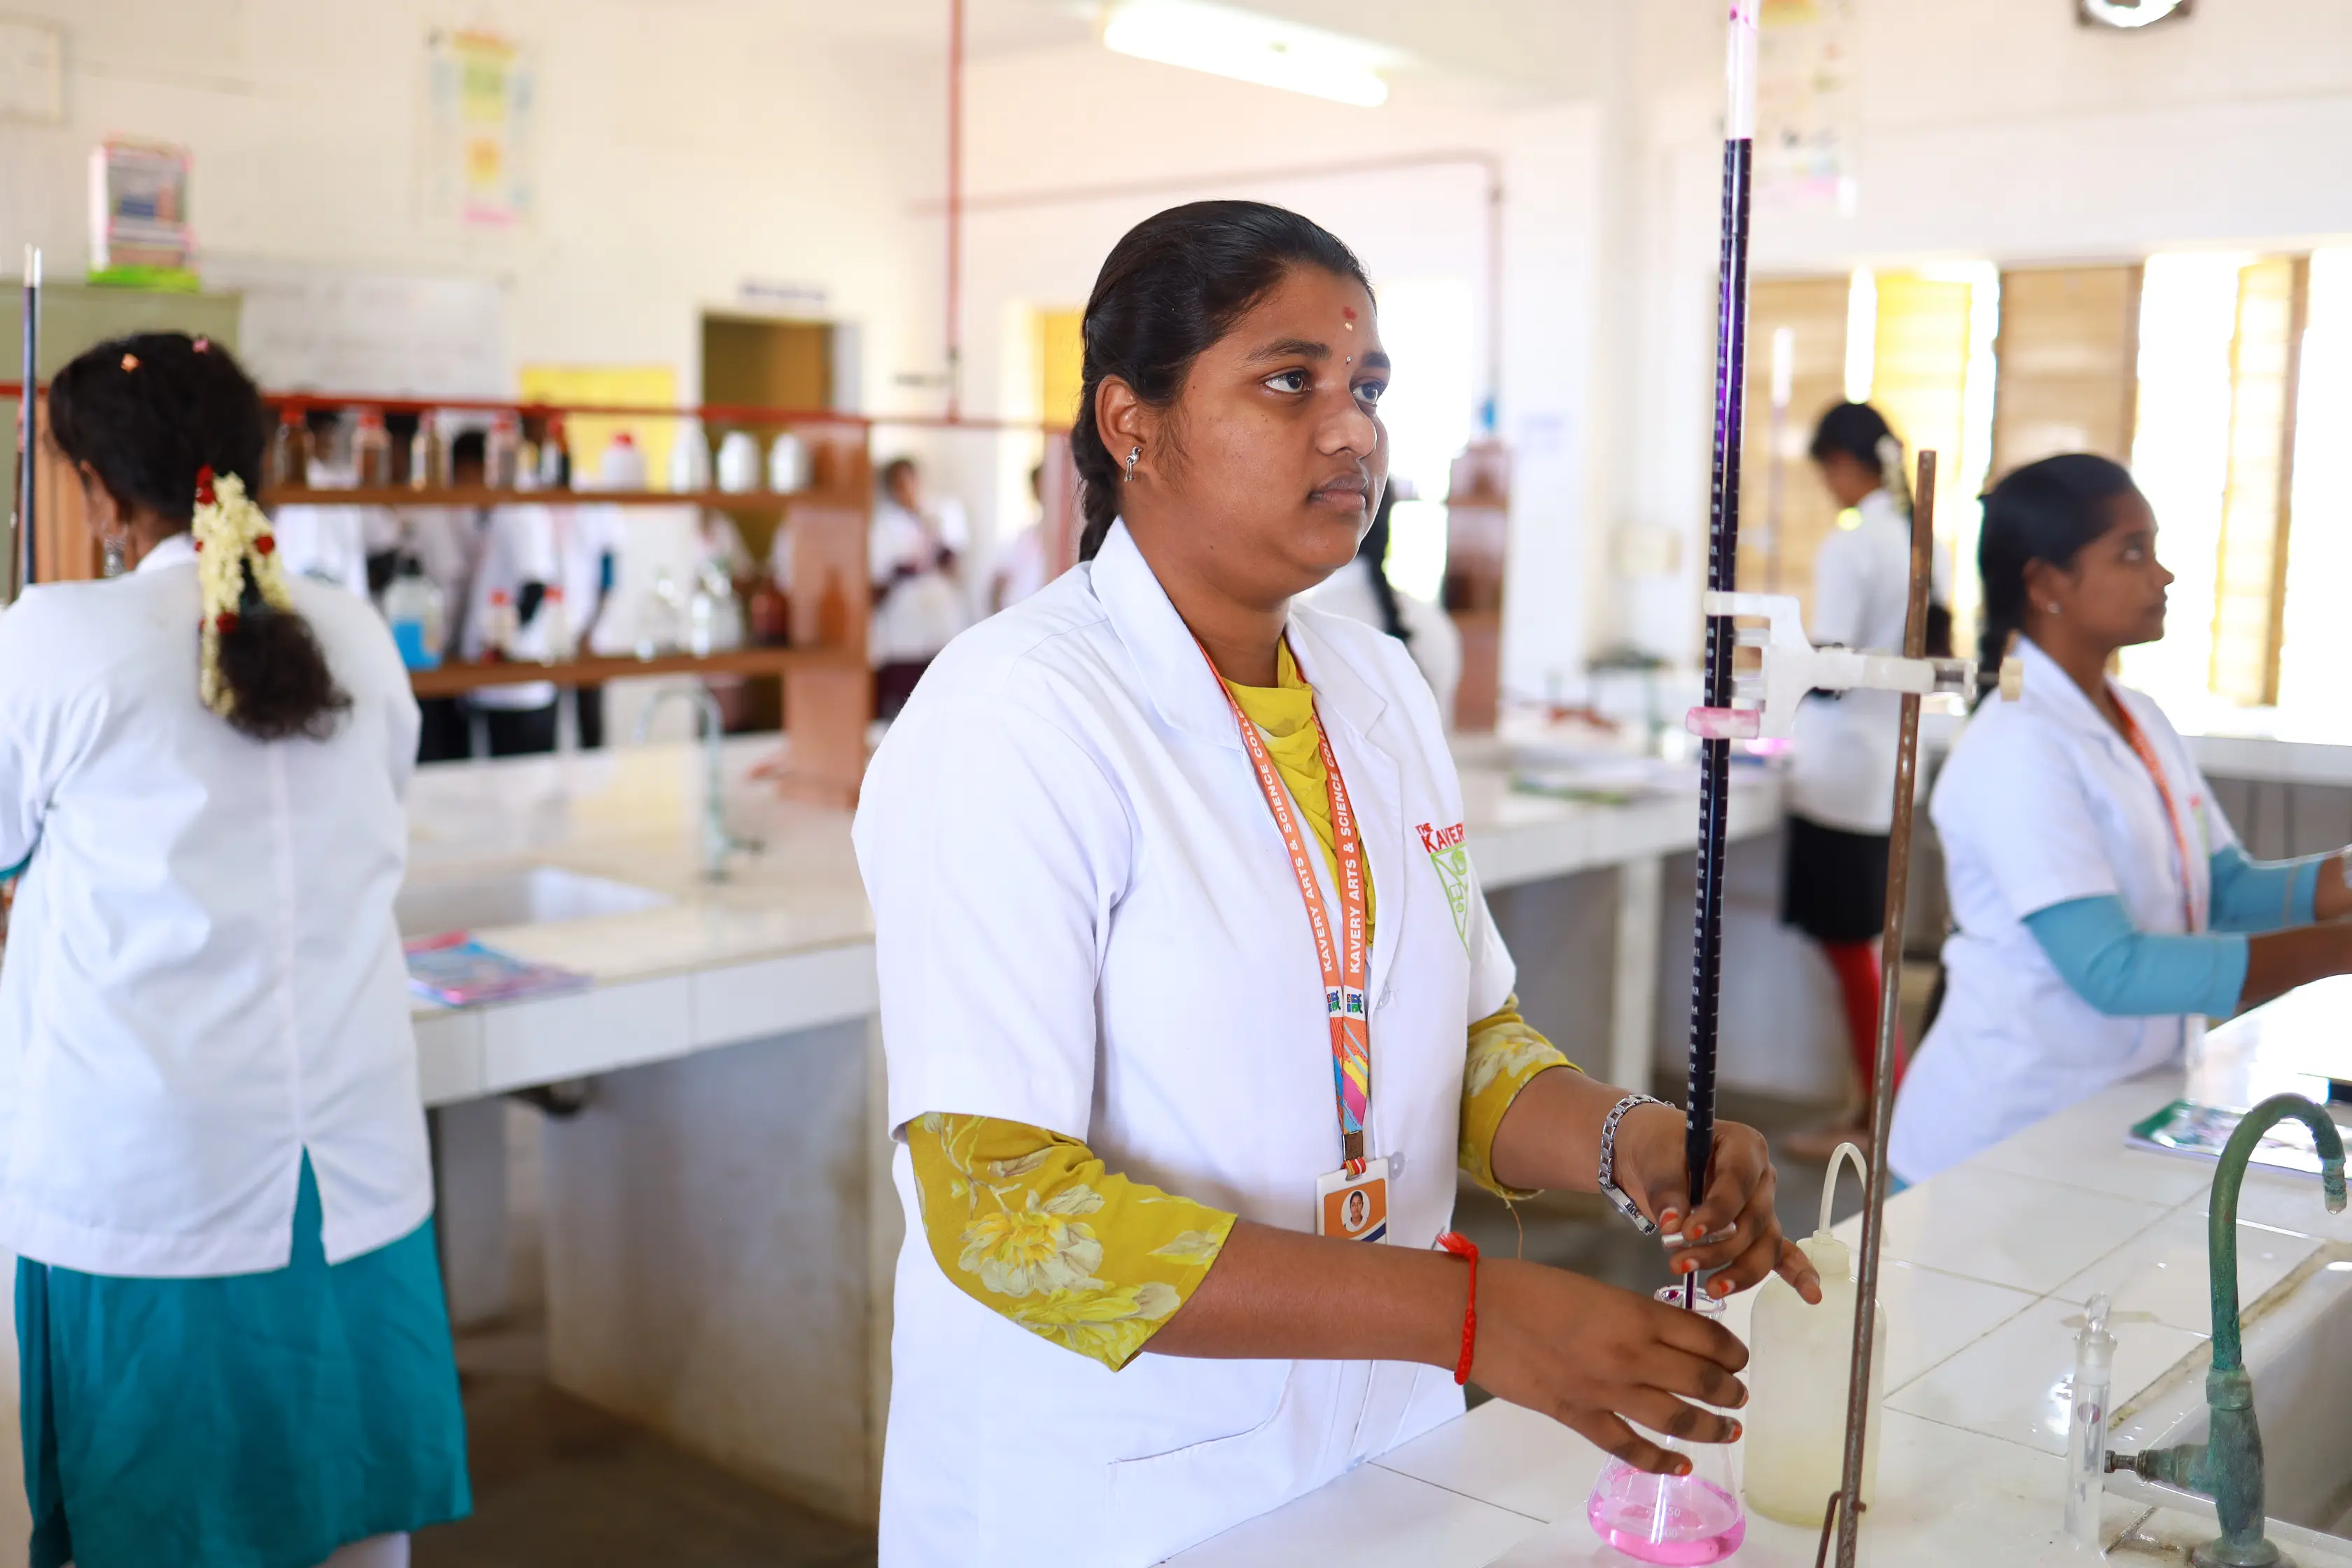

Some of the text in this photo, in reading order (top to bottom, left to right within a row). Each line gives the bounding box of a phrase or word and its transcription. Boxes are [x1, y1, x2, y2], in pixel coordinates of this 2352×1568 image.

[1260, 764, 1292, 833] SCIENCE
[1331, 772, 1351, 836] SCIENCE
[1289, 839, 1298, 850] &
[1343, 842, 1354, 853] &
[1415, 822, 1433, 835] THE
[1422, 822, 1466, 853] KAVER
[1295, 857, 1315, 899] ARTS
[1345, 859, 1359, 901] ARTS
[1310, 906, 1332, 972] KAVERY
[1350, 906, 1361, 973] KAVERY
